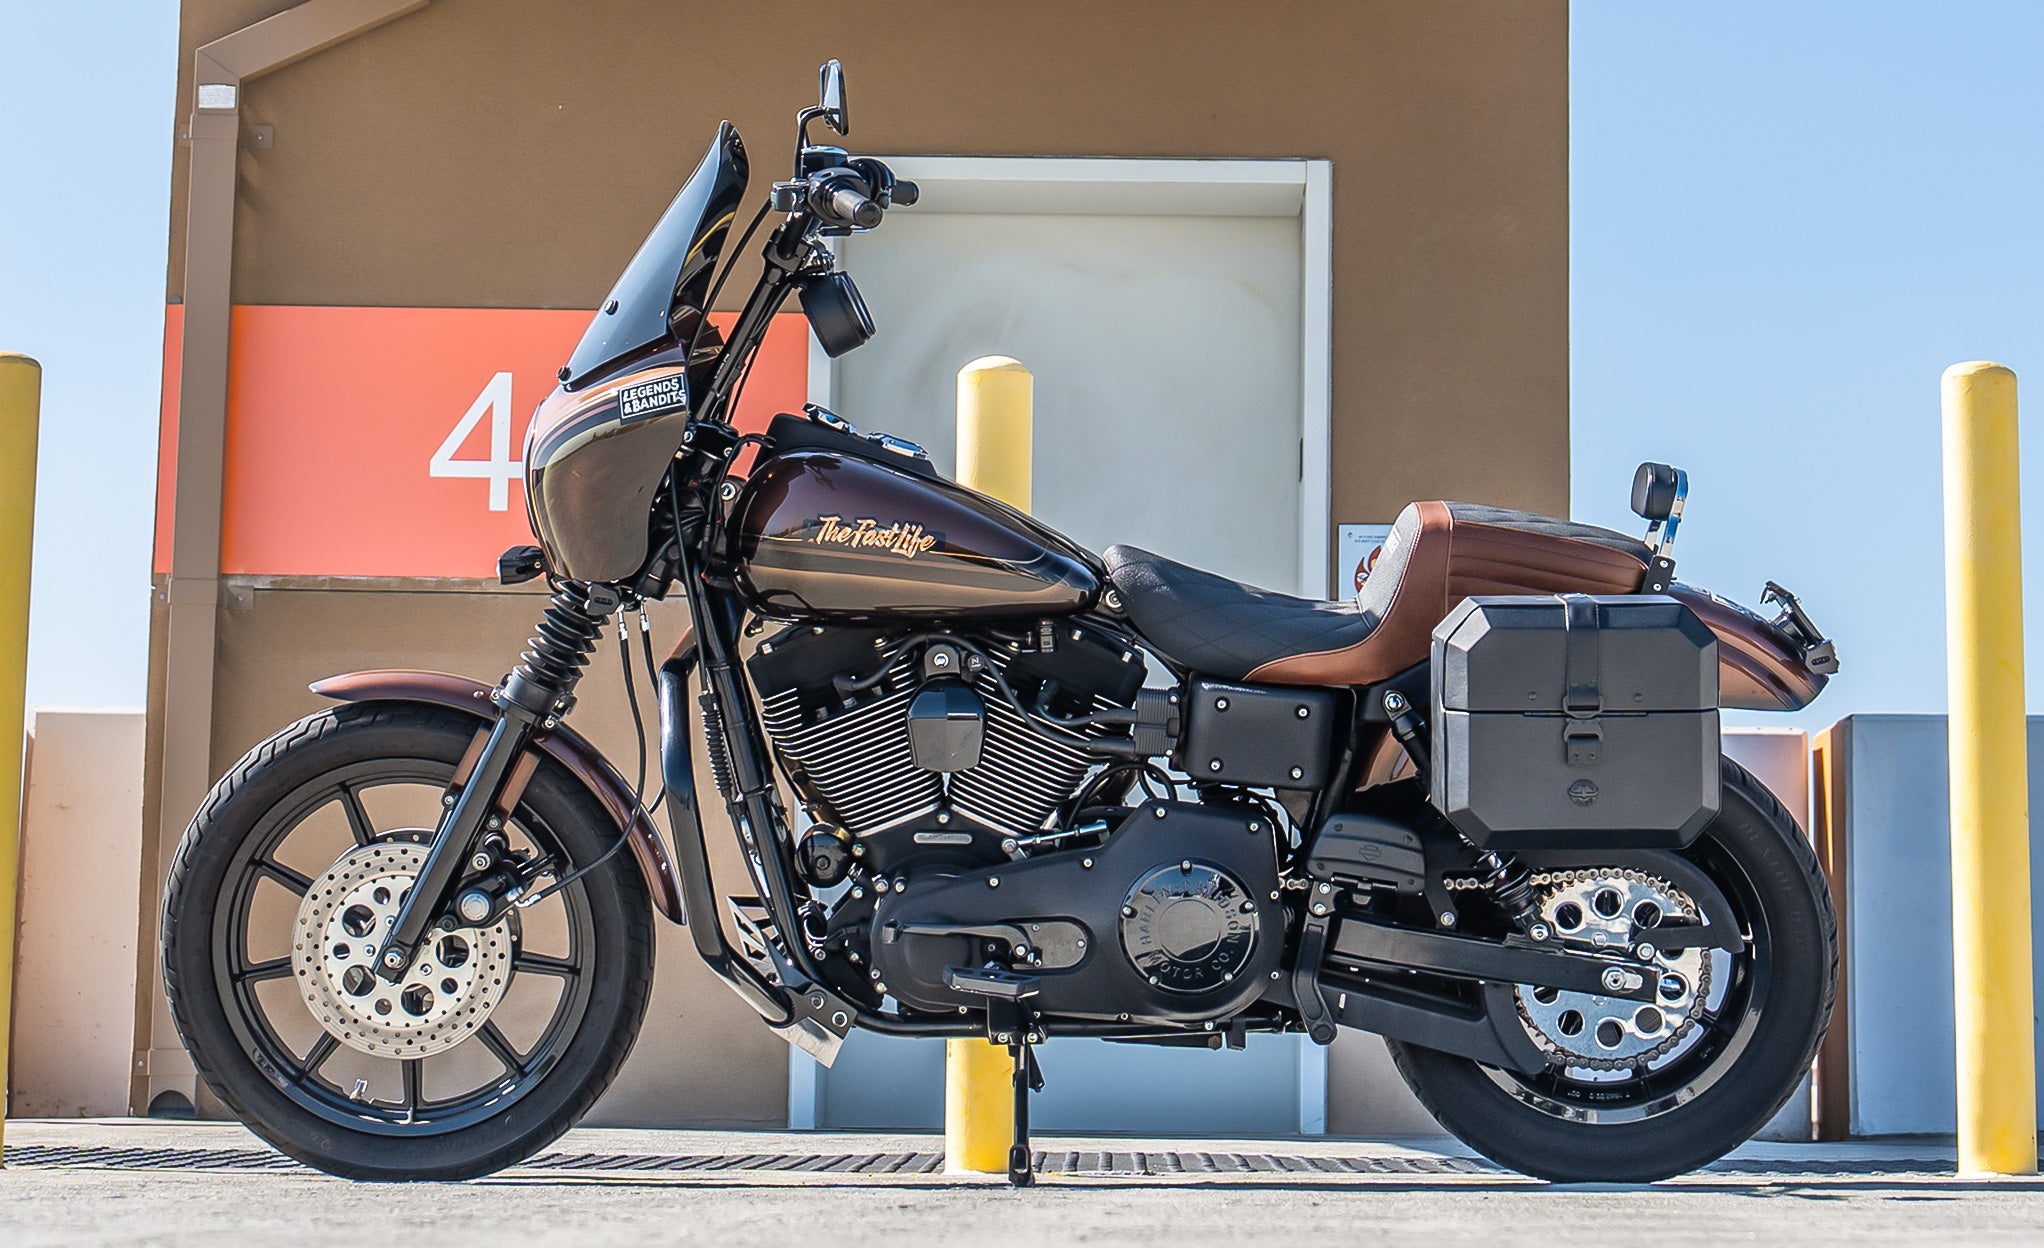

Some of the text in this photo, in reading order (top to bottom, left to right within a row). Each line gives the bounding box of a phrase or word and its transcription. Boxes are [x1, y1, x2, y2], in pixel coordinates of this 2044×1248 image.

[623, 378, 680, 403] LEGENDS
[624, 389, 687, 414] &BANDITS
[429, 371, 523, 511] 4
[816, 516, 852, 544] The
